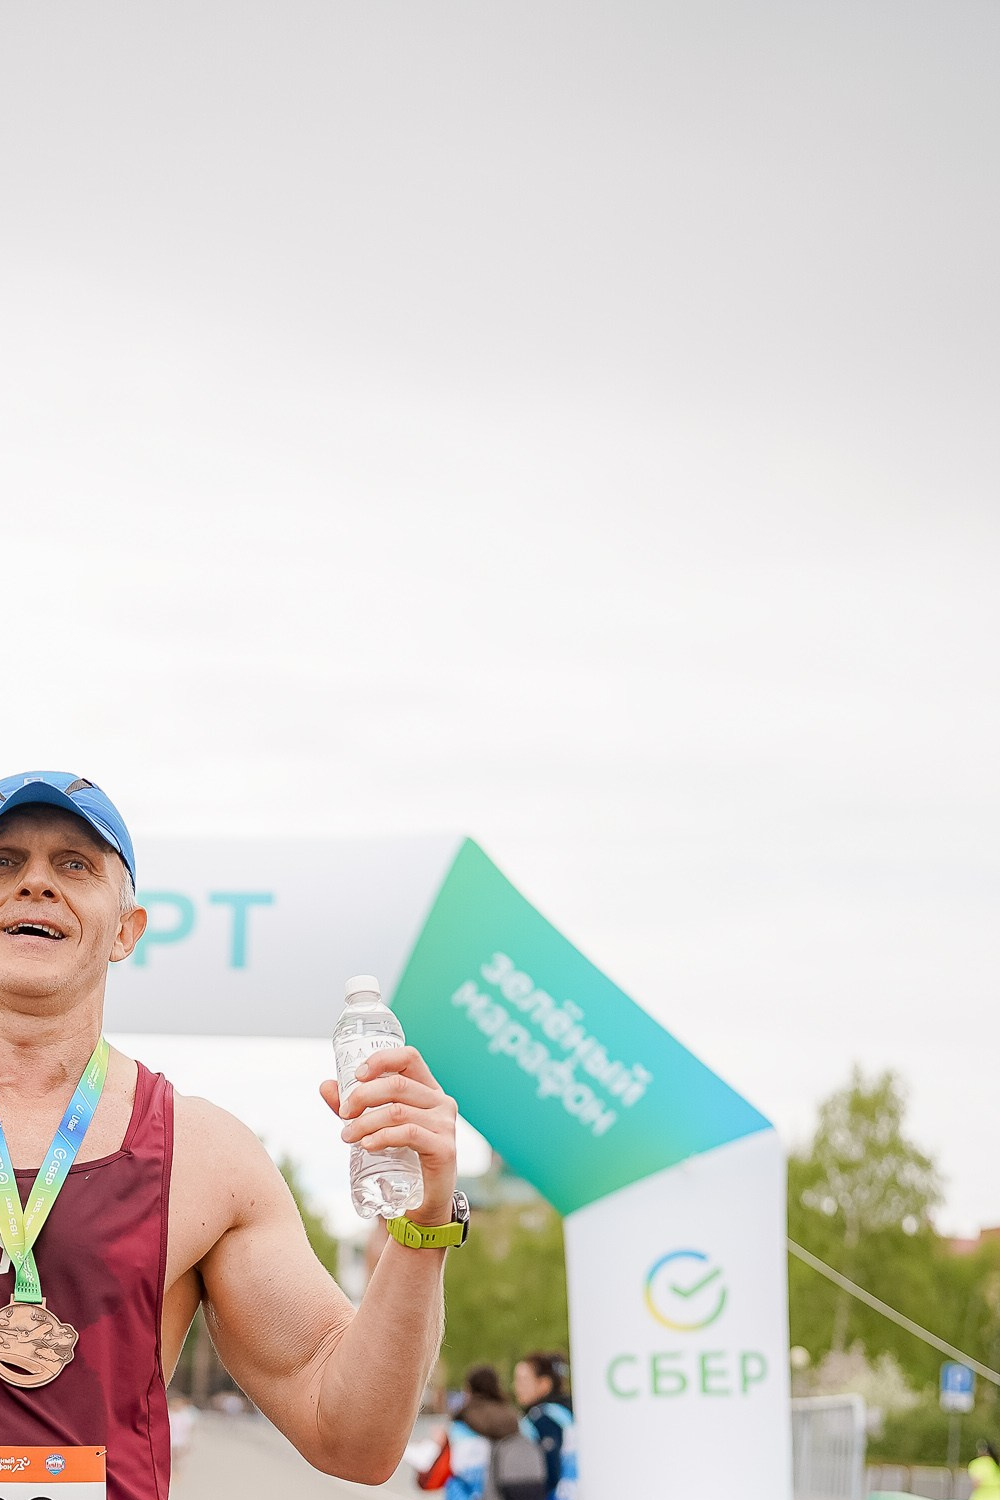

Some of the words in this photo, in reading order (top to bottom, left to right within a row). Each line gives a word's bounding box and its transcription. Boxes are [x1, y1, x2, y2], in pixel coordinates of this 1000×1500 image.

[451, 980, 617, 1137] марафон
[45, 1161, 61, 1186] СБЕР
[8, 1218, 19, 1236] 185
[606, 1350, 768, 1399] СБЕР
